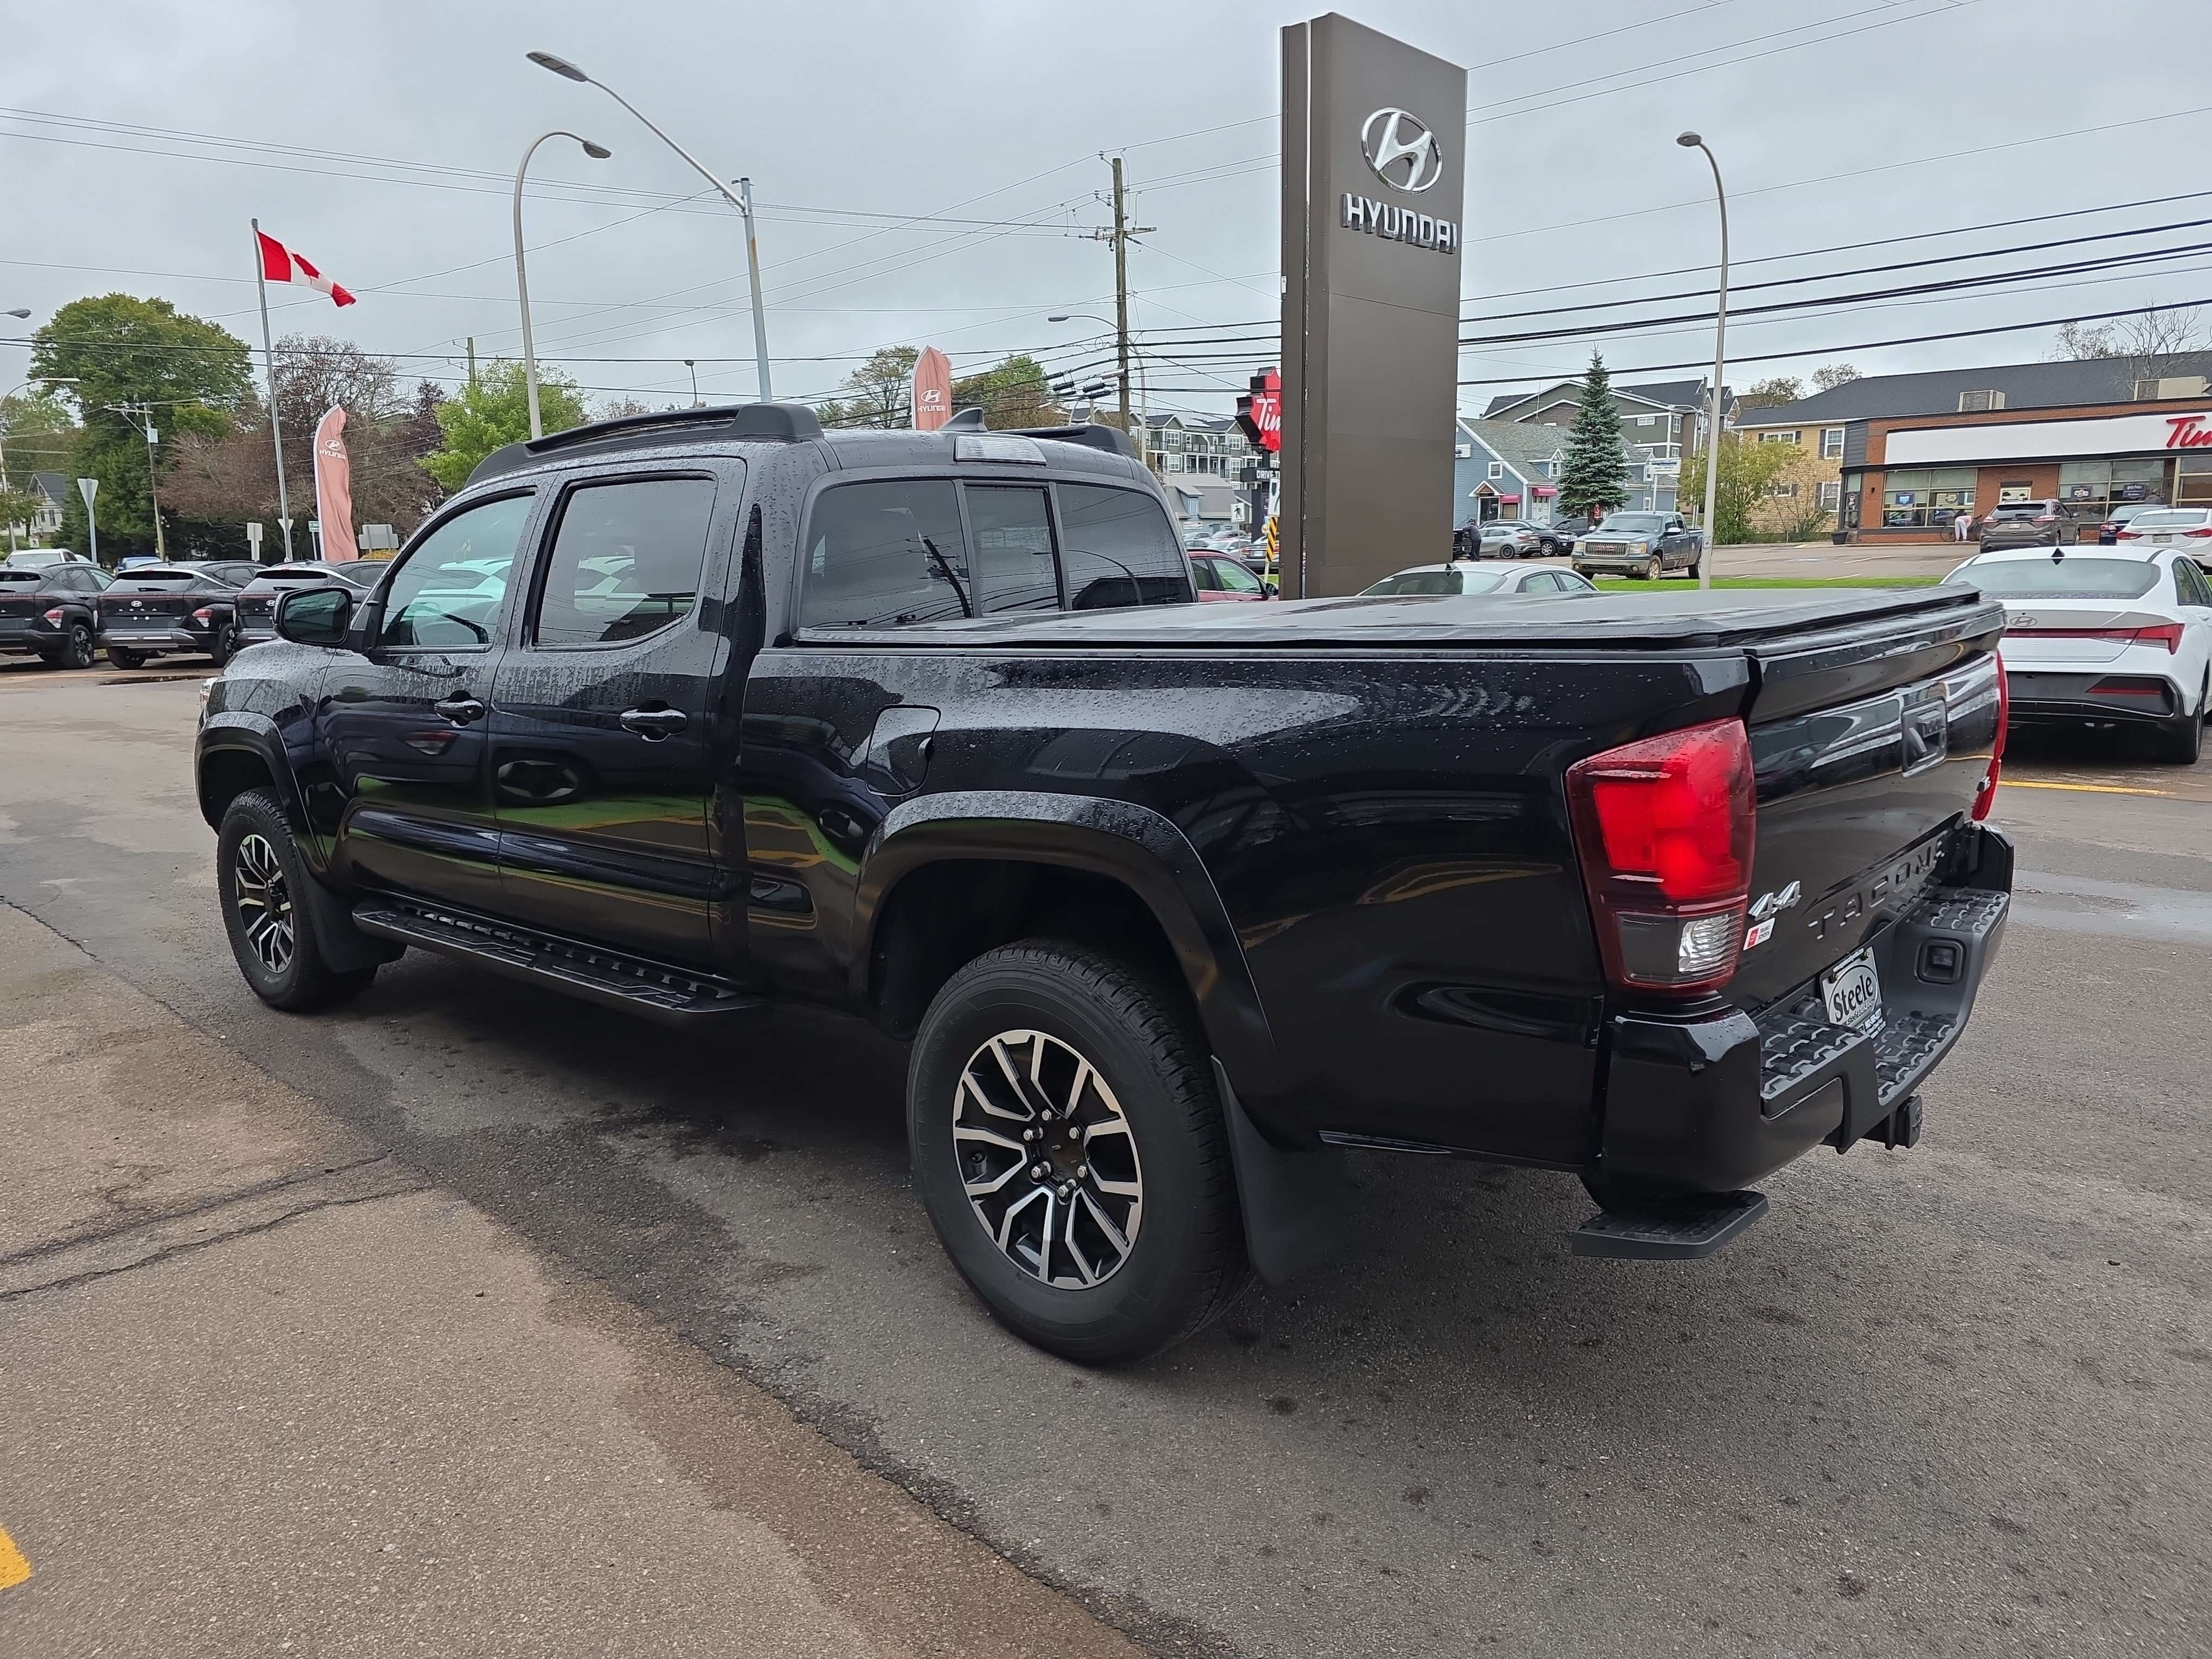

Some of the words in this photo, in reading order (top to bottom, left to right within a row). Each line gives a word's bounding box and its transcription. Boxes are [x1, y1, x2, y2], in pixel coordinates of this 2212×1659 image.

[1340, 192, 1457, 254] HYUNDAI
[1256, 470, 1274, 479] DRIVE
[1833, 974, 1874, 1023] Steele
